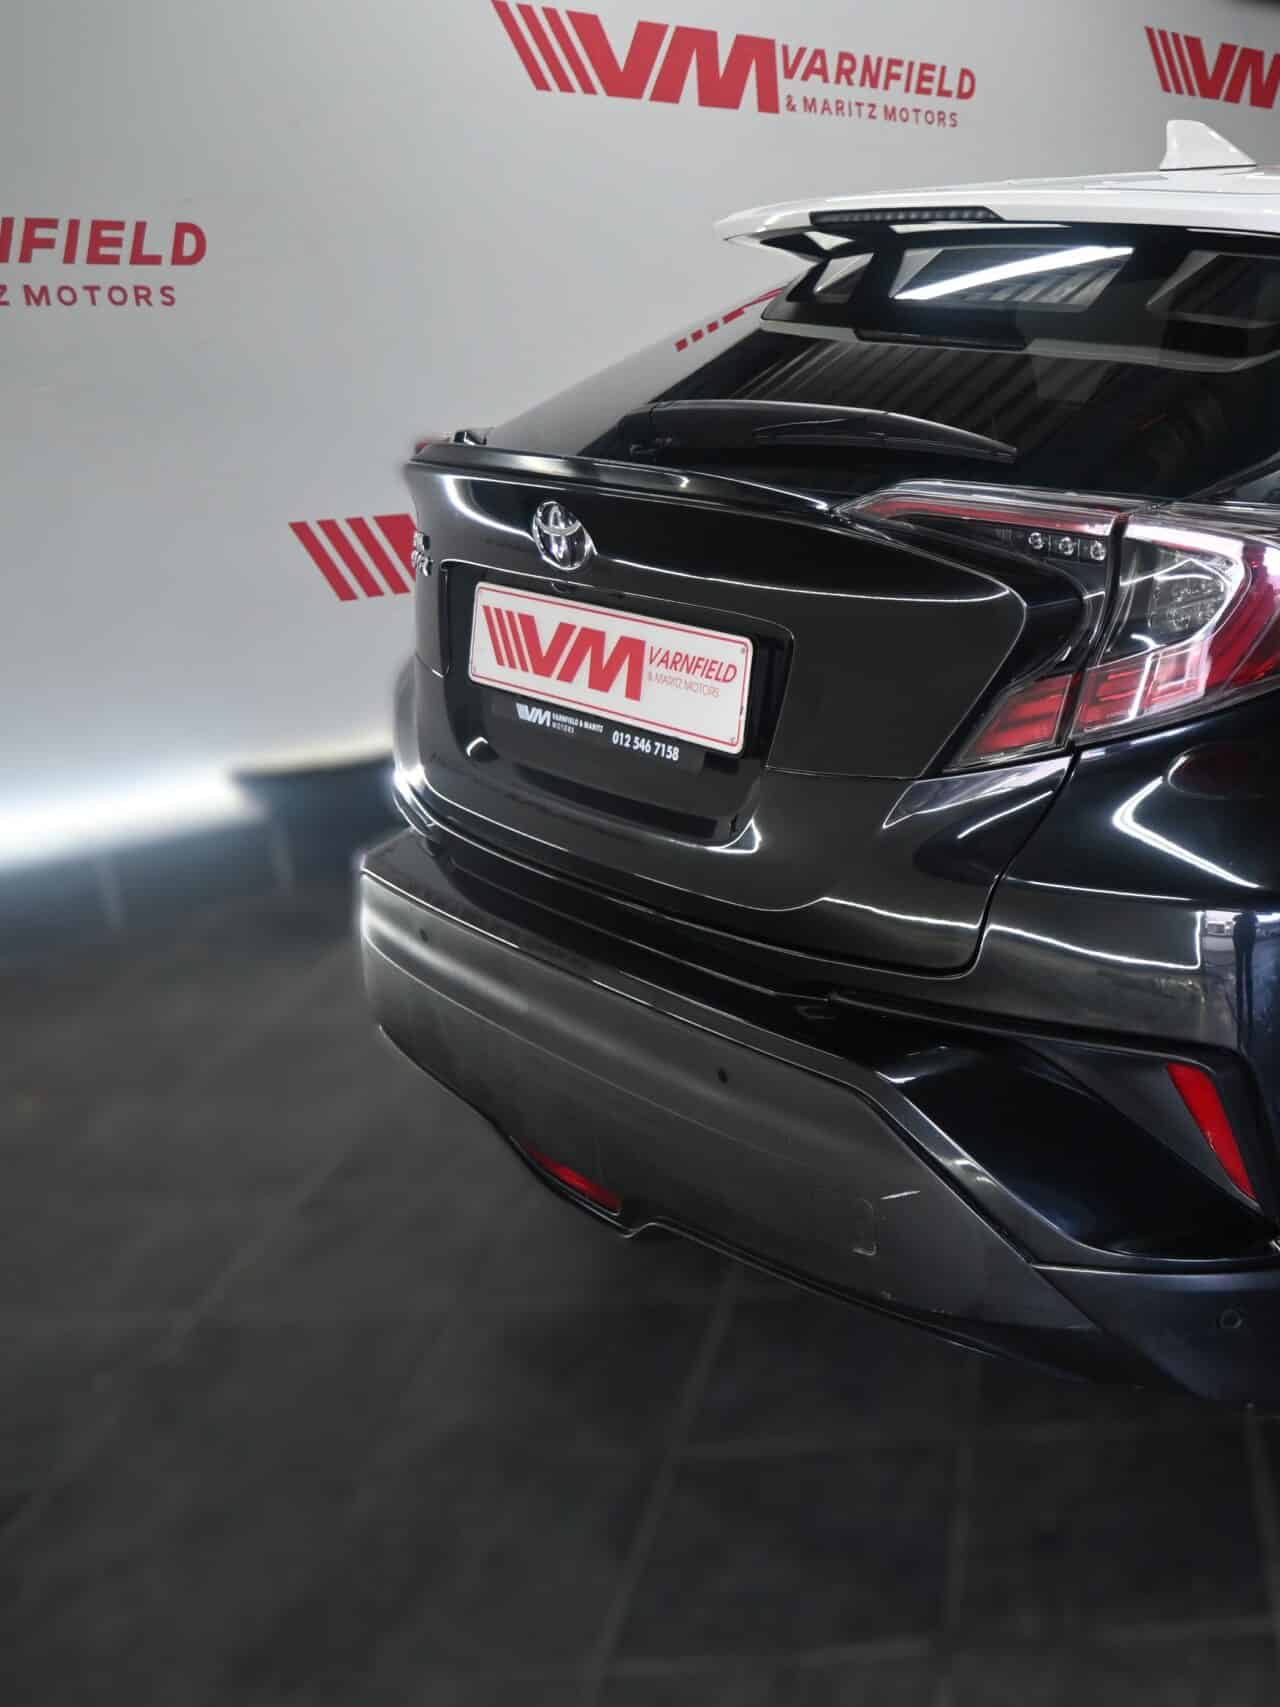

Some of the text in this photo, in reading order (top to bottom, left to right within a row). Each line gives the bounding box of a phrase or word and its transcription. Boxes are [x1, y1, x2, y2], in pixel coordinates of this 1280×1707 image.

[781, 44, 977, 101] VARNFIELD
[785, 94, 959, 129] & MARITZ MOTORS
[23, 284, 177, 308] MOTORS
[648, 645, 738, 684] VARNFIELD
[612, 730, 680, 761] 012 546 7158
